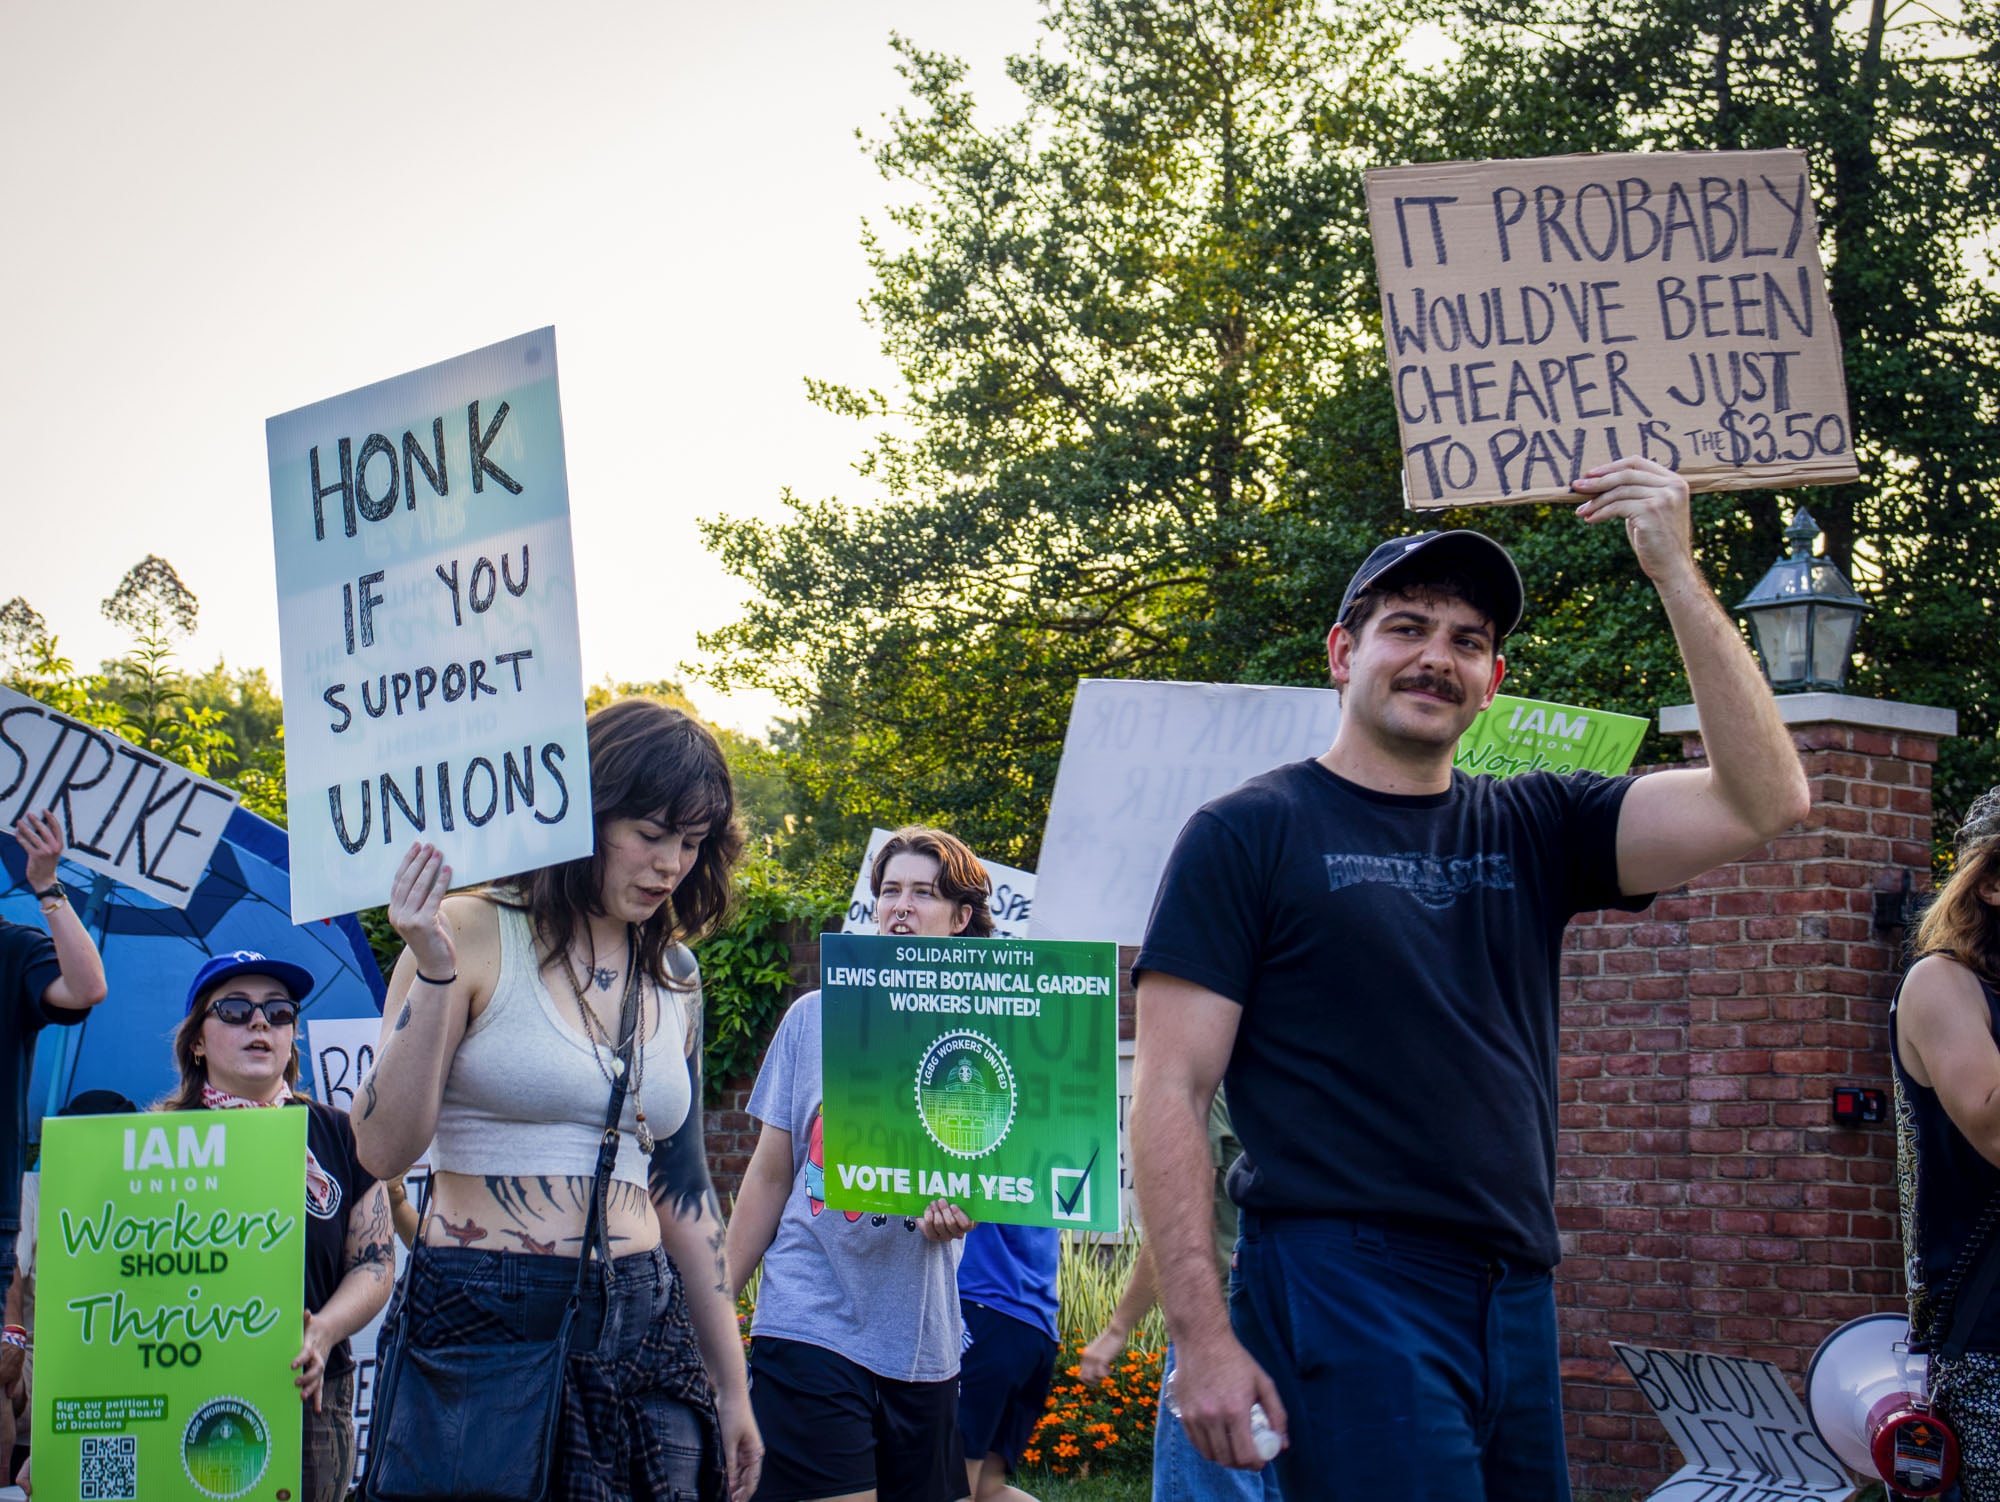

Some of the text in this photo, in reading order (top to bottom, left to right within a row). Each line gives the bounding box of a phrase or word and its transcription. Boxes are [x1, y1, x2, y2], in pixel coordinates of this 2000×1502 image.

[1394, 173, 1806, 268] IT PROBABLY
[1387, 266, 1814, 357] WOULD'VE BEEN
[1398, 350, 1801, 425] CHEAPER JUST
[310, 400, 523, 541] HONK
[1406, 434, 1478, 499] TO
[1488, 427, 1587, 496] PAY
[1684, 429, 1726, 456] THE
[1715, 409, 1846, 468] $3.50
[342, 569, 385, 655] IF
[436, 544, 529, 626] YOU
[323, 650, 534, 734] SUPPORT
[1508, 706, 1590, 741] IAM
[1508, 735, 1573, 752] UNION
[0, 706, 234, 893] STRIKE
[328, 742, 569, 855] UNIONS
[827, 966, 1110, 996] LEWIS GINTER BOTANICAL GARDEN
[895, 947, 1034, 966] SOLIDARITY WITH
[888, 992, 1040, 1017] WORKERS UNITED!
[922, 1056, 940, 1086] LGBG
[936, 1038, 983, 1059] WORKERS
[983, 1048, 1008, 1090] UNITED
[123, 1123, 226, 1171] IAM
[129, 1175, 219, 1194] UNION
[836, 1163, 1035, 1204] VOTE IAM YES
[60, 1199, 296, 1257] Workers
[120, 1251, 229, 1277] SHOULD
[67, 1285, 281, 1346] Thrive
[138, 1342, 202, 1369] TOO
[56, 1397, 165, 1412] Sign our petition to
[1614, 1345, 1803, 1425] BOYCOTT
[56, 1408, 162, 1420] the CEO and Board
[56, 1420, 123, 1431] of Directors
[200, 1402, 243, 1421] WORKERS
[242, 1408, 264, 1442] UNITED
[1675, 1415, 1849, 1493] LEWIS
